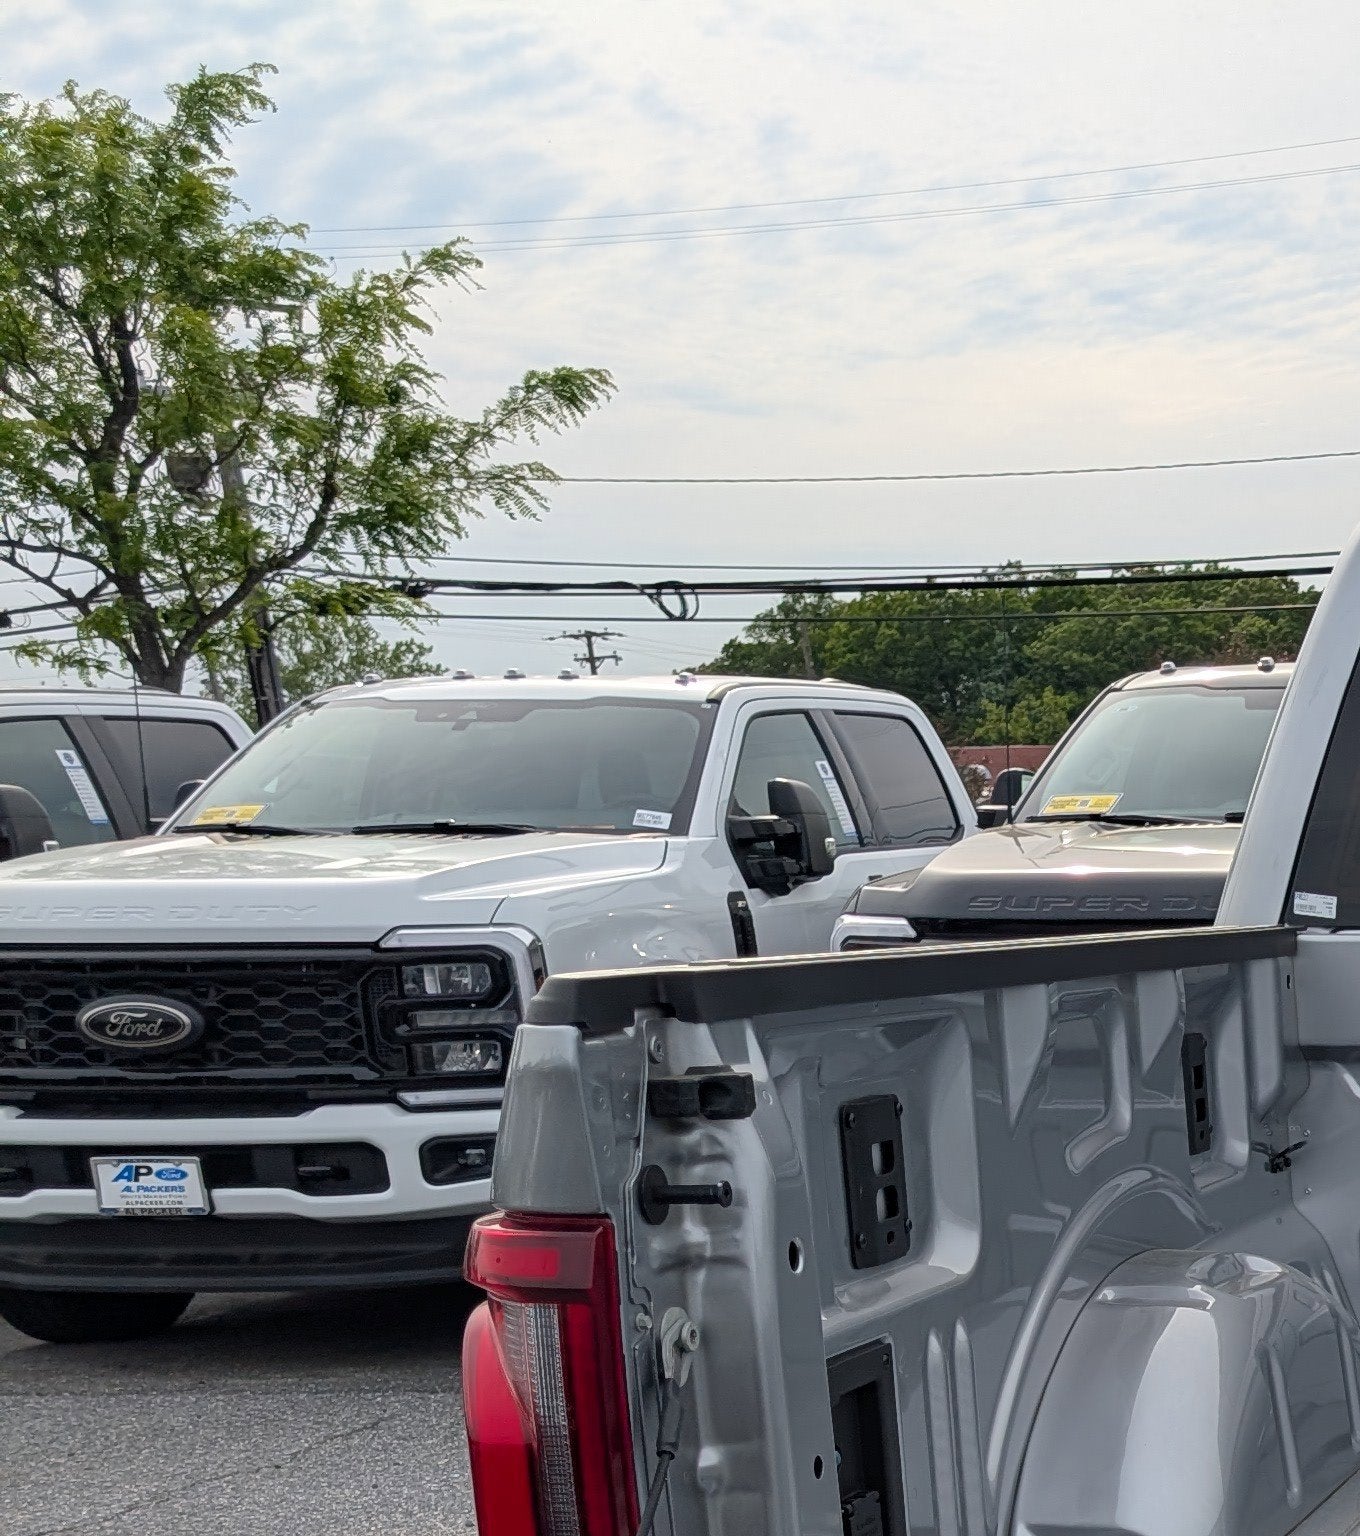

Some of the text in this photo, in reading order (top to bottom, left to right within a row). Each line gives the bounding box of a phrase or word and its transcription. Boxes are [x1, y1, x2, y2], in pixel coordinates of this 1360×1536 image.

[968, 895, 1150, 912] SUPER
[167, 905, 319, 922] DUTY
[105, 1011, 164, 1038] Ford
[111, 1164, 154, 1183] AP
[121, 1185, 135, 1193] AL
[140, 1207, 183, 1216] PACKER
